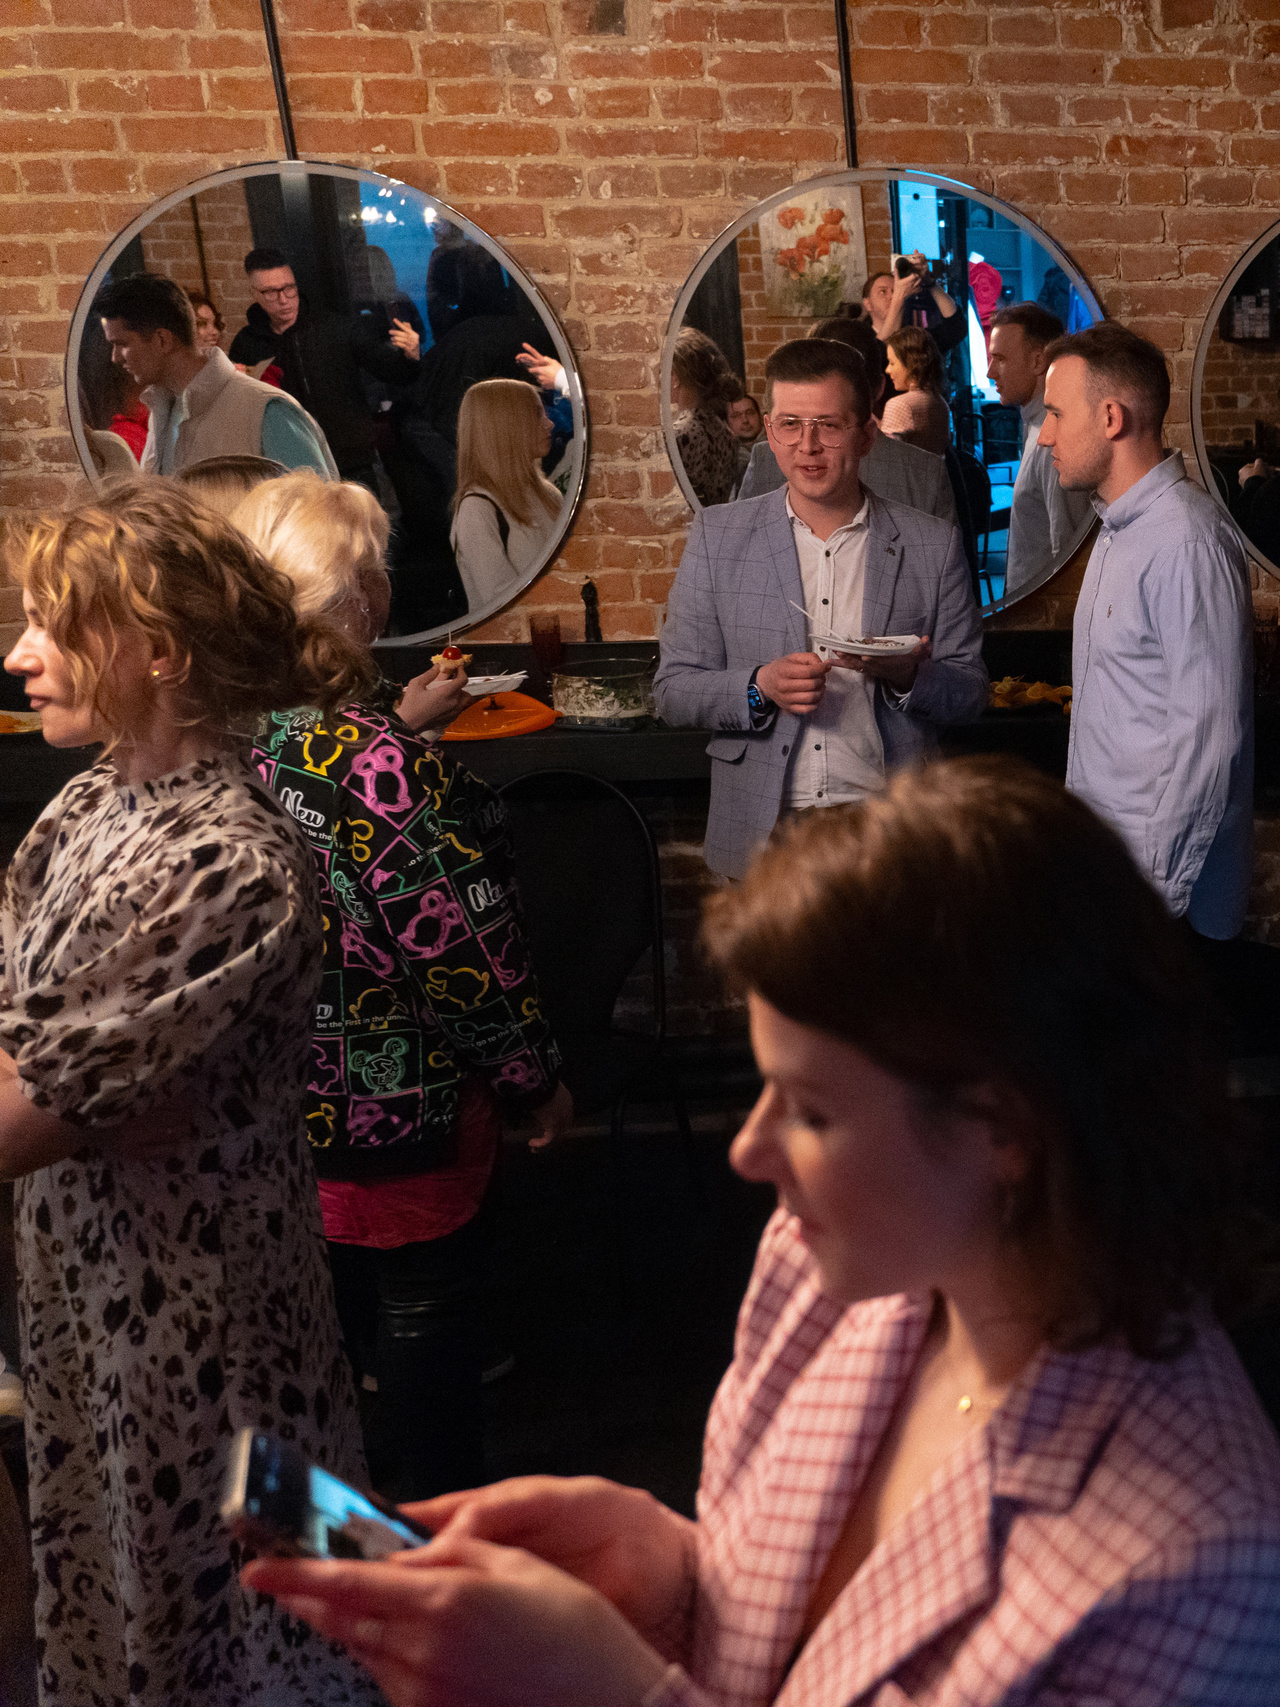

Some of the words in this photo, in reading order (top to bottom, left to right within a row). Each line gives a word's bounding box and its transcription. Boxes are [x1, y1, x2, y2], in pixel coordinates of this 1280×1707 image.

[279, 787, 326, 828] New
[308, 828, 318, 838] be
[318, 832, 333, 841] the
[316, 1021, 328, 1029] be
[329, 1020, 344, 1028] the
[476, 1039, 487, 1047] go
